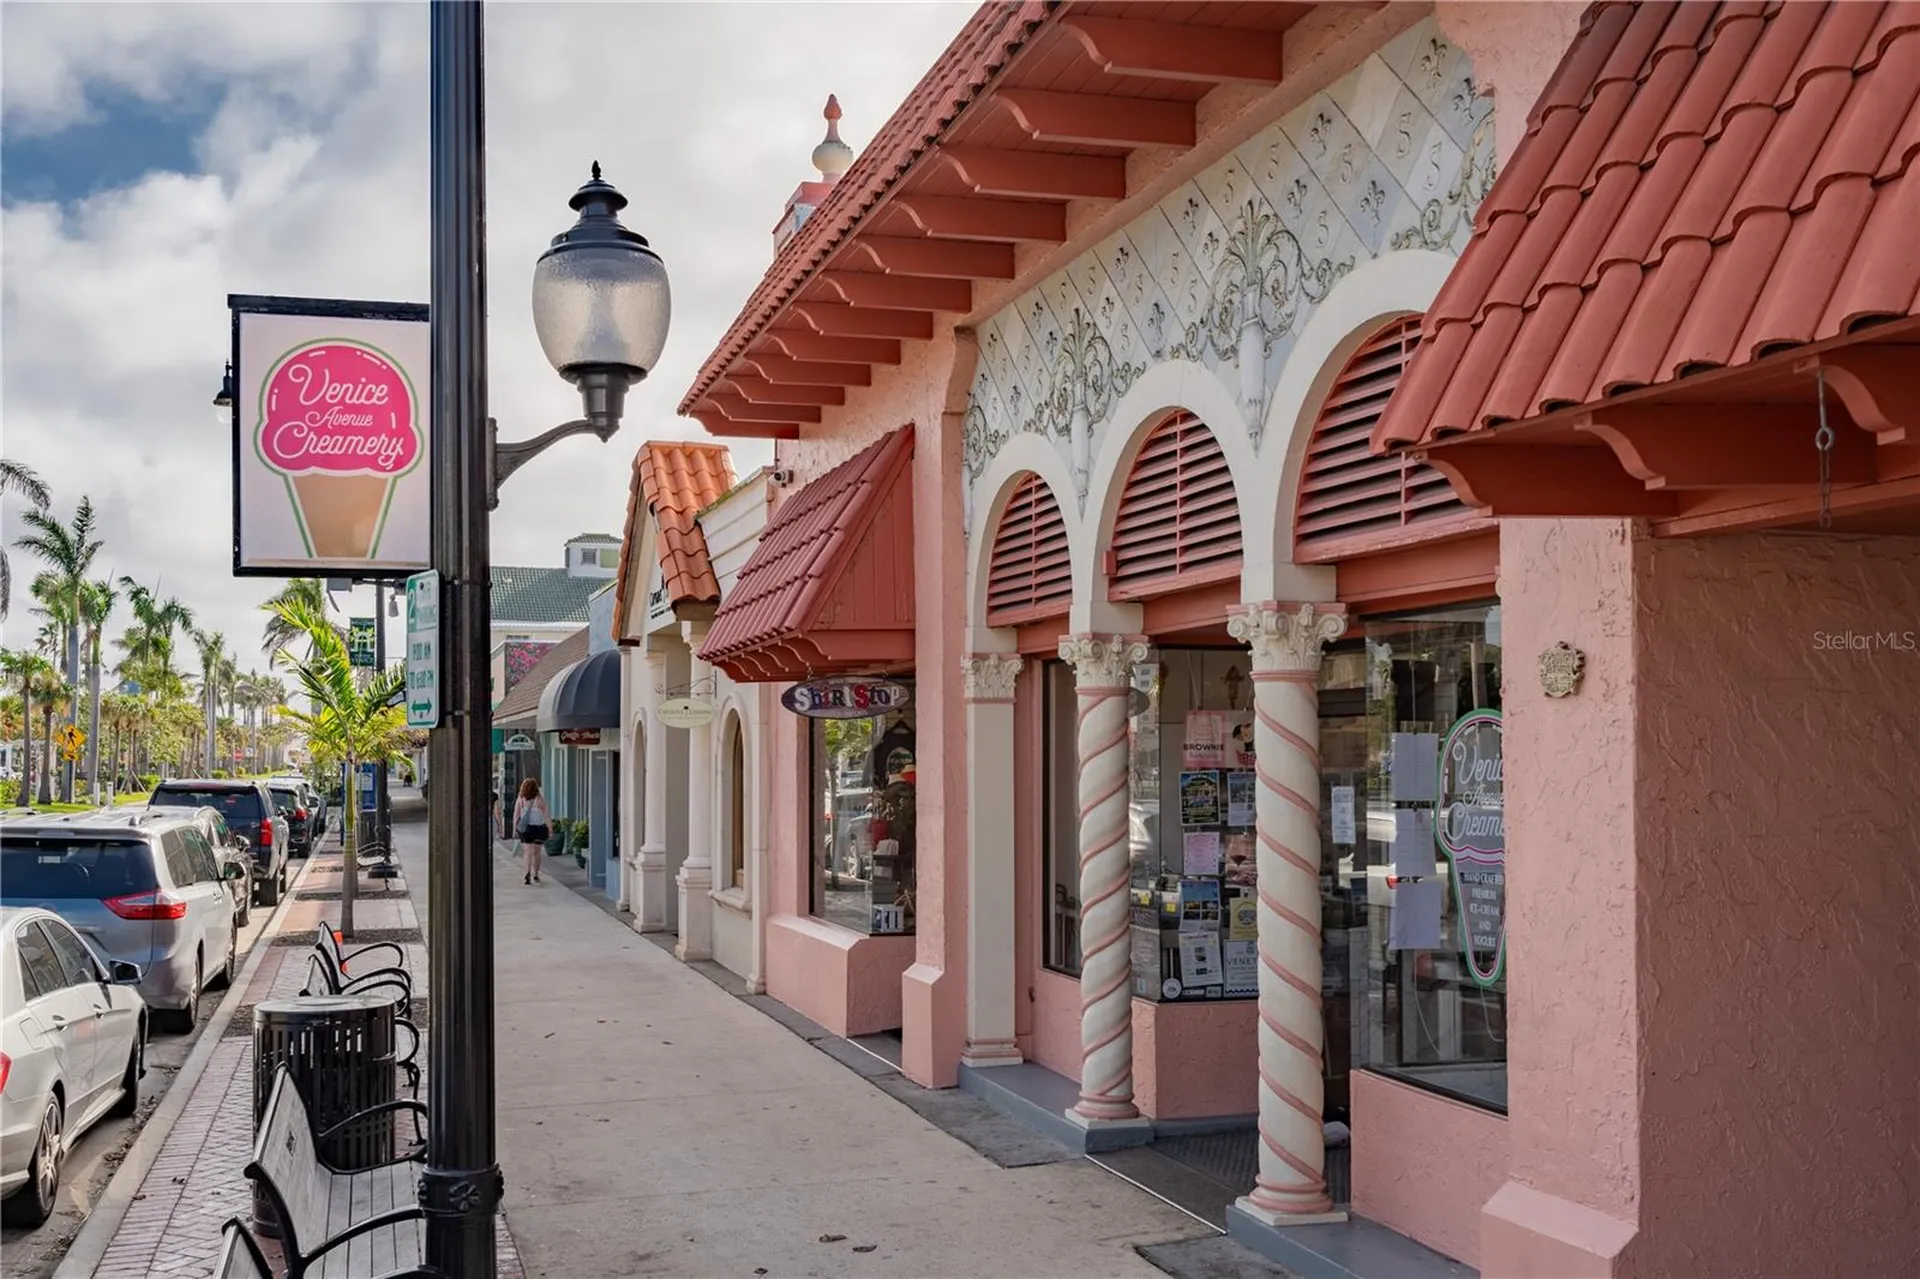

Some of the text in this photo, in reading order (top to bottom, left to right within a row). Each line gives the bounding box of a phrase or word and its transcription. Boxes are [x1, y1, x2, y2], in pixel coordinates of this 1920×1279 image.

[288, 363, 389, 405] Venice
[305, 406, 373, 429] Avenue
[273, 421, 404, 467] Creamery
[1452, 741, 1504, 785] Venic
[1446, 802, 1505, 841] Cream
